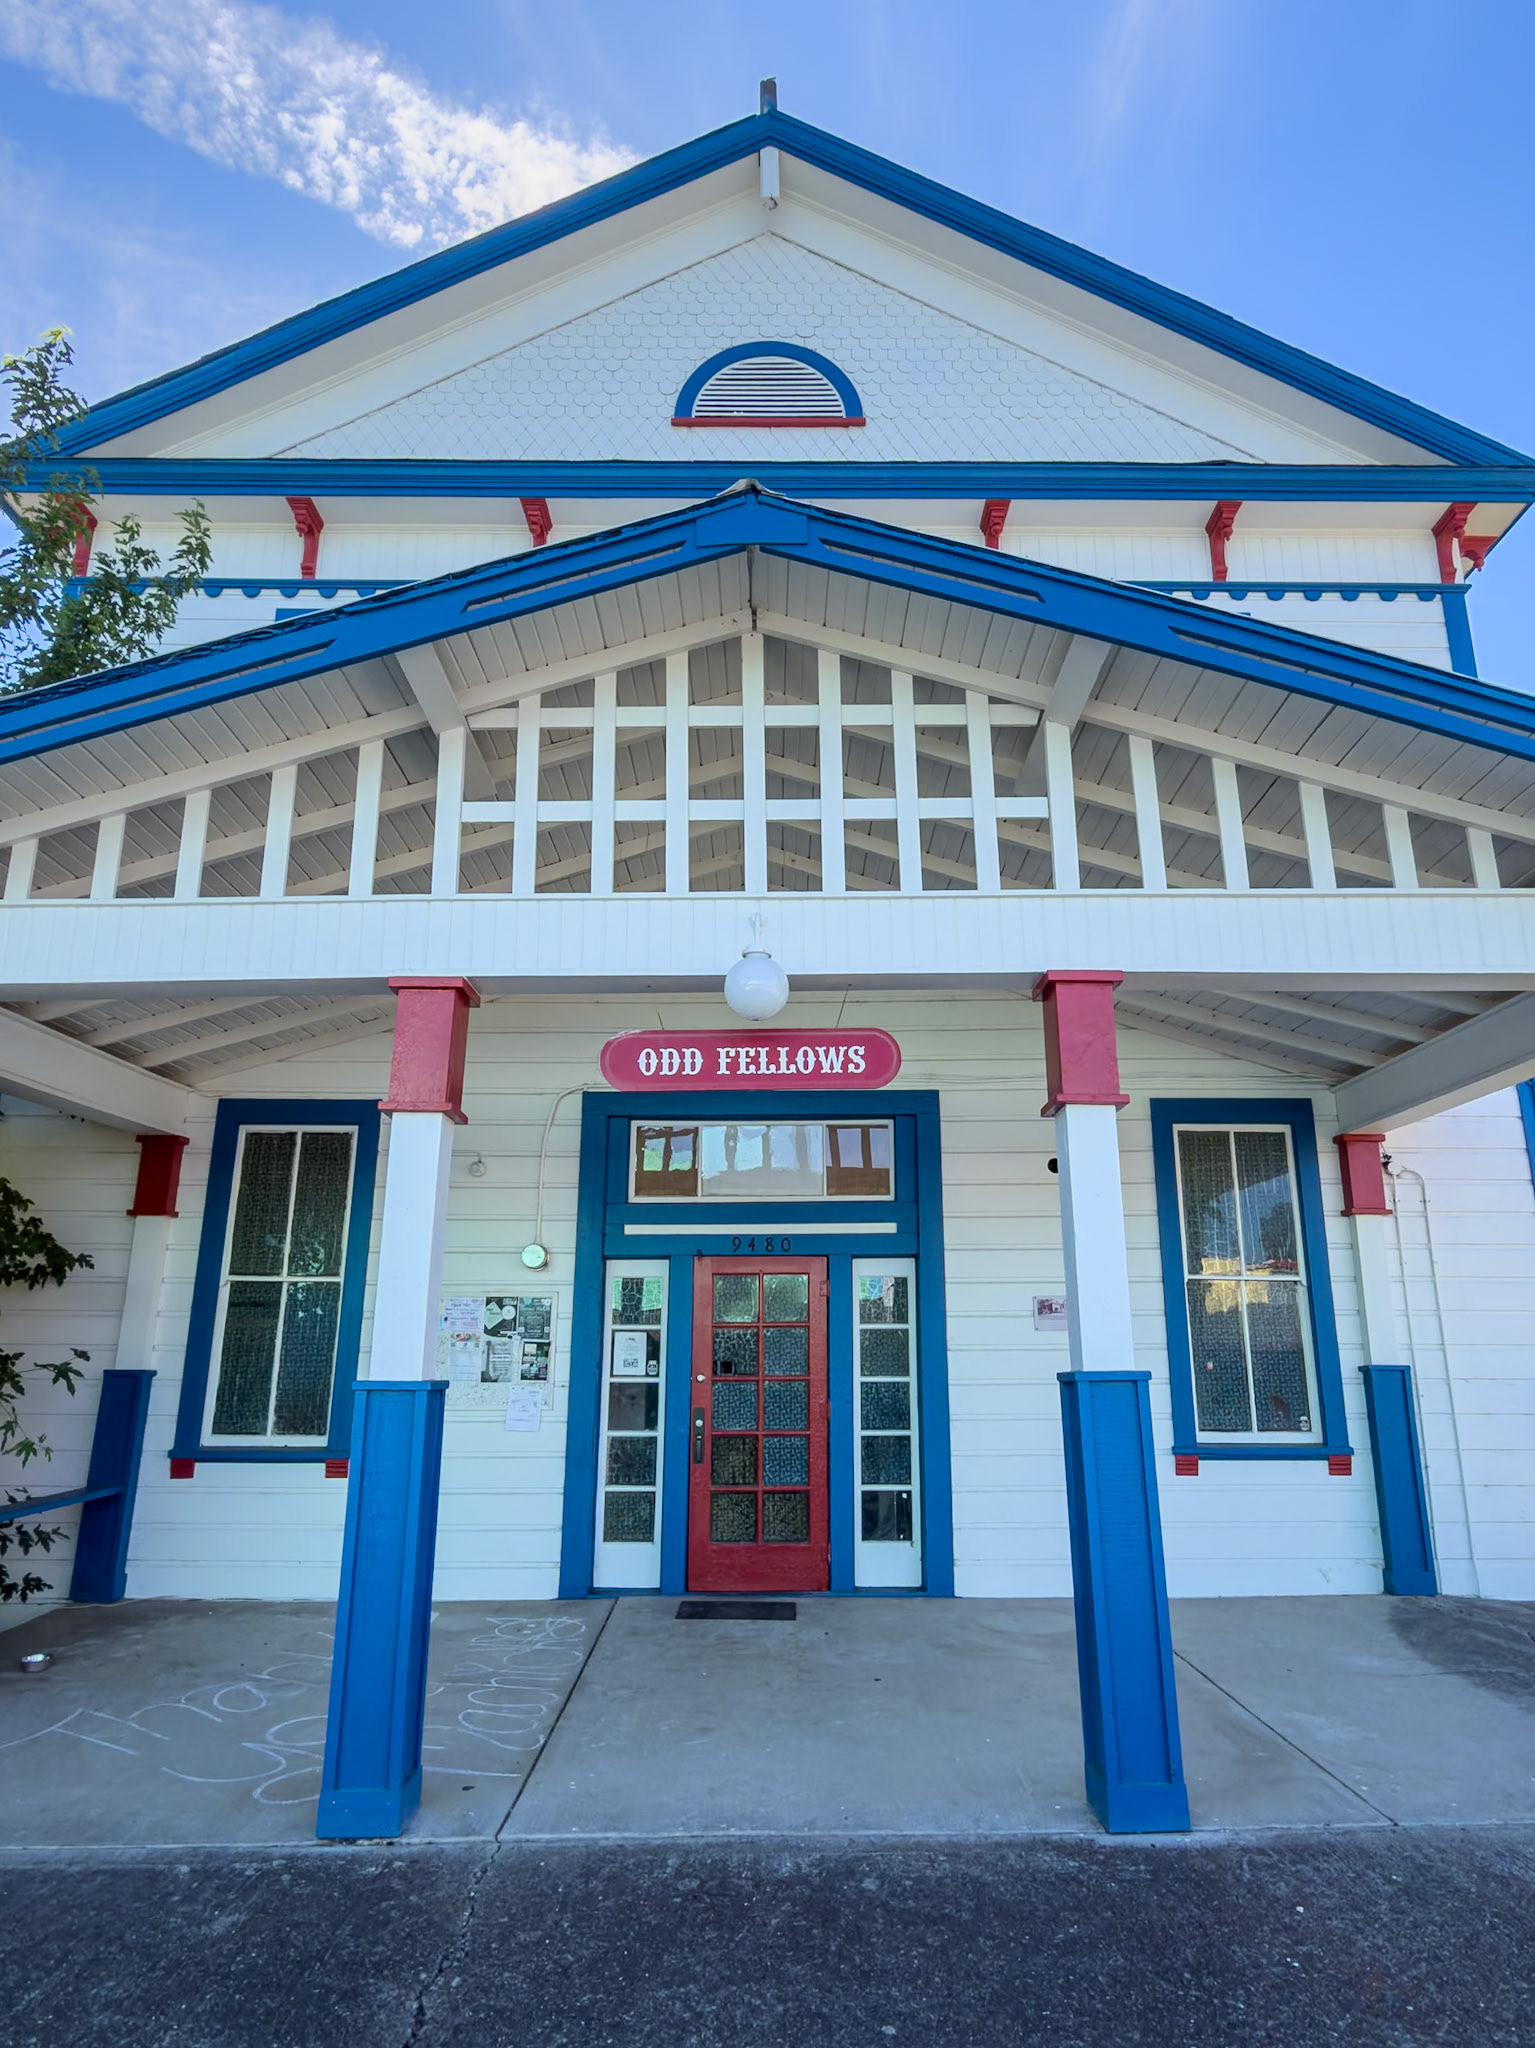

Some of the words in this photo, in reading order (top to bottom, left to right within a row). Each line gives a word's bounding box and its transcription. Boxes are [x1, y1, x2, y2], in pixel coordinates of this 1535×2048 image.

[637, 1047, 703, 1077] ODD
[716, 1045, 867, 1076] FELLOWS
[731, 1236, 792, 1253] 9480
